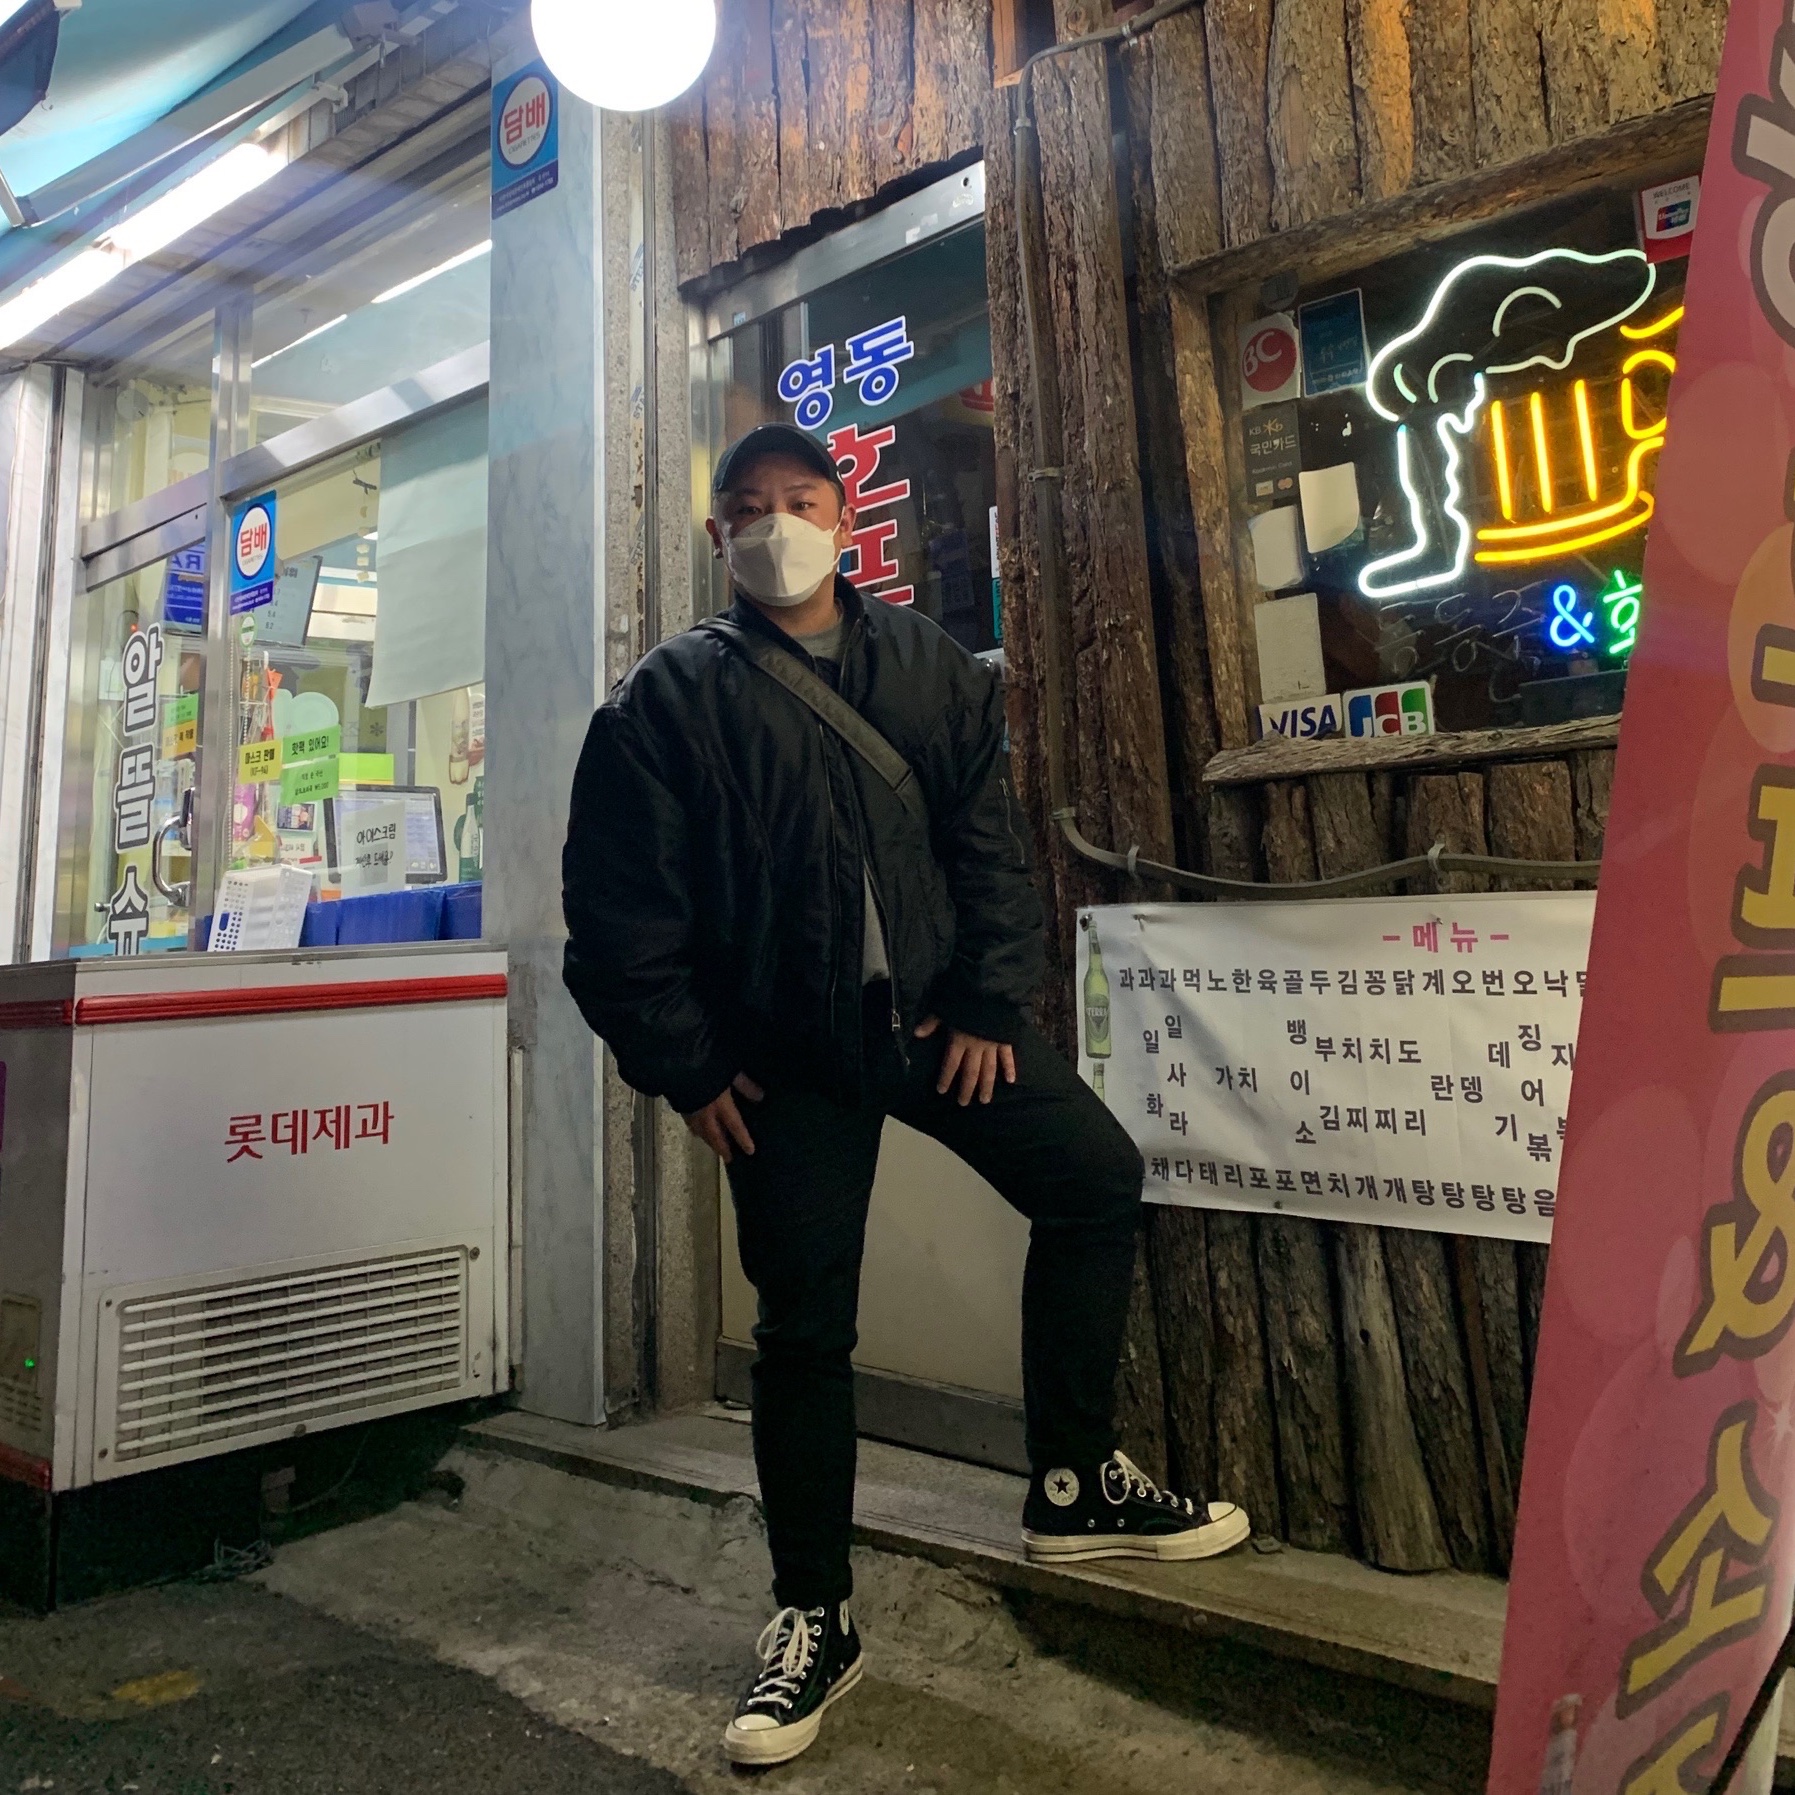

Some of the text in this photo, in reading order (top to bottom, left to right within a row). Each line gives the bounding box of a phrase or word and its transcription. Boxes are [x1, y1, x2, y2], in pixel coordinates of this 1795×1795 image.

[504, 92, 546, 145] 담배
[778, 315, 914, 430] 영동
[1243, 331, 1283, 377] BC
[1250, 434, 1298, 456] 국민카드
[240, 522, 268, 558] 담배
[1549, 584, 1596, 648] &
[1269, 704, 1337, 738] VISA
[1351, 702, 1428, 737] JCB
[356, 822, 396, 845] 아이스크림
[225, 1101, 394, 1163] 롯데제과
